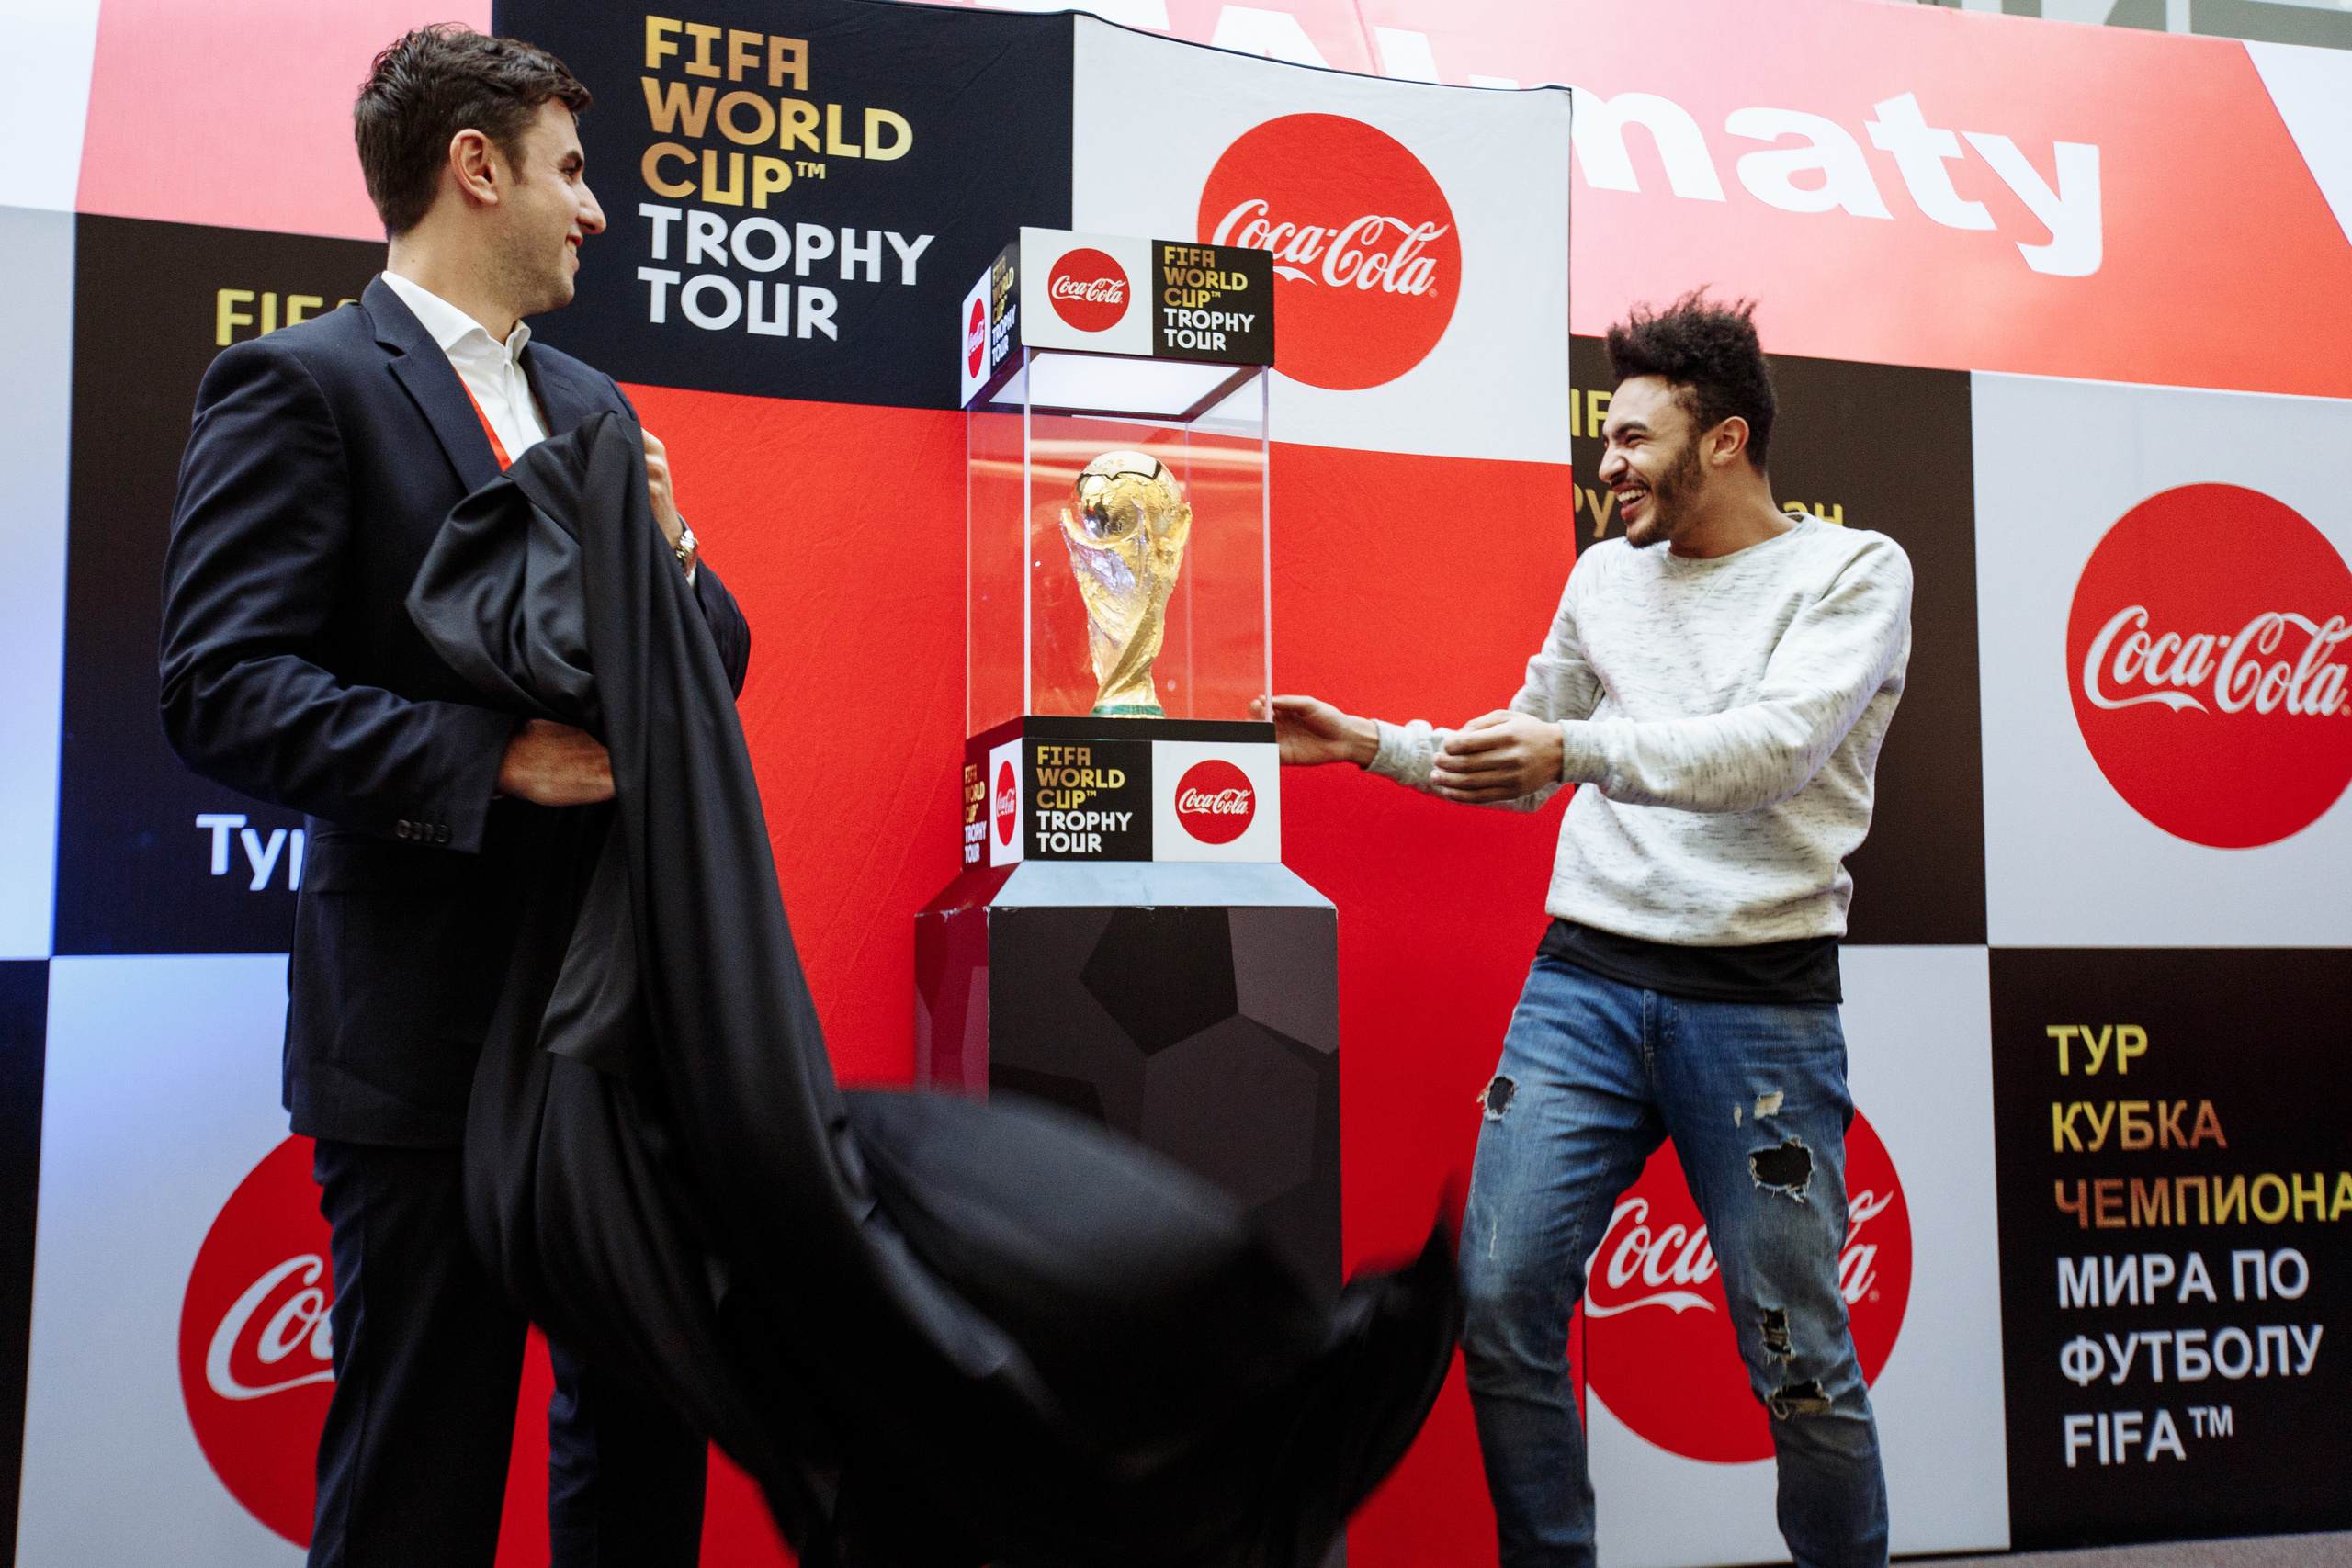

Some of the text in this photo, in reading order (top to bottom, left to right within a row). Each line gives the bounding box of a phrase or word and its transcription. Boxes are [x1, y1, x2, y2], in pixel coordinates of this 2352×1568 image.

[645, 15, 809, 91] FIFA
[640, 76, 914, 162] WORLD
[638, 203, 935, 286] TROPHY
[1164, 245, 1216, 268] FIFA
[1051, 275, 1127, 305] Coca-Cola
[1163, 266, 1248, 291] WORLD
[216, 288, 358, 346] FIF
[637, 266, 838, 342] TOUR
[1163, 307, 1255, 333] TROPHY
[1163, 328, 1227, 351] TOUR
[1037, 745, 1091, 766] FIFA
[1036, 768, 1125, 789] WORLD
[1179, 787, 1252, 816] Coca-Cola
[1036, 810, 1133, 832] TROPHY
[965, 842, 980, 863] TOUR
[1036, 831, 1102, 853] TOUR
[2046, 1025, 2148, 1076] ТУР
[2052, 1100, 2227, 1153] КУБКА
[2054, 1171, 2352, 1229] ЧЕМПИОНА
[2057, 1247, 2309, 1309] МИРА ПО
[2060, 1324, 2324, 1387] ФУТБОЛУ
